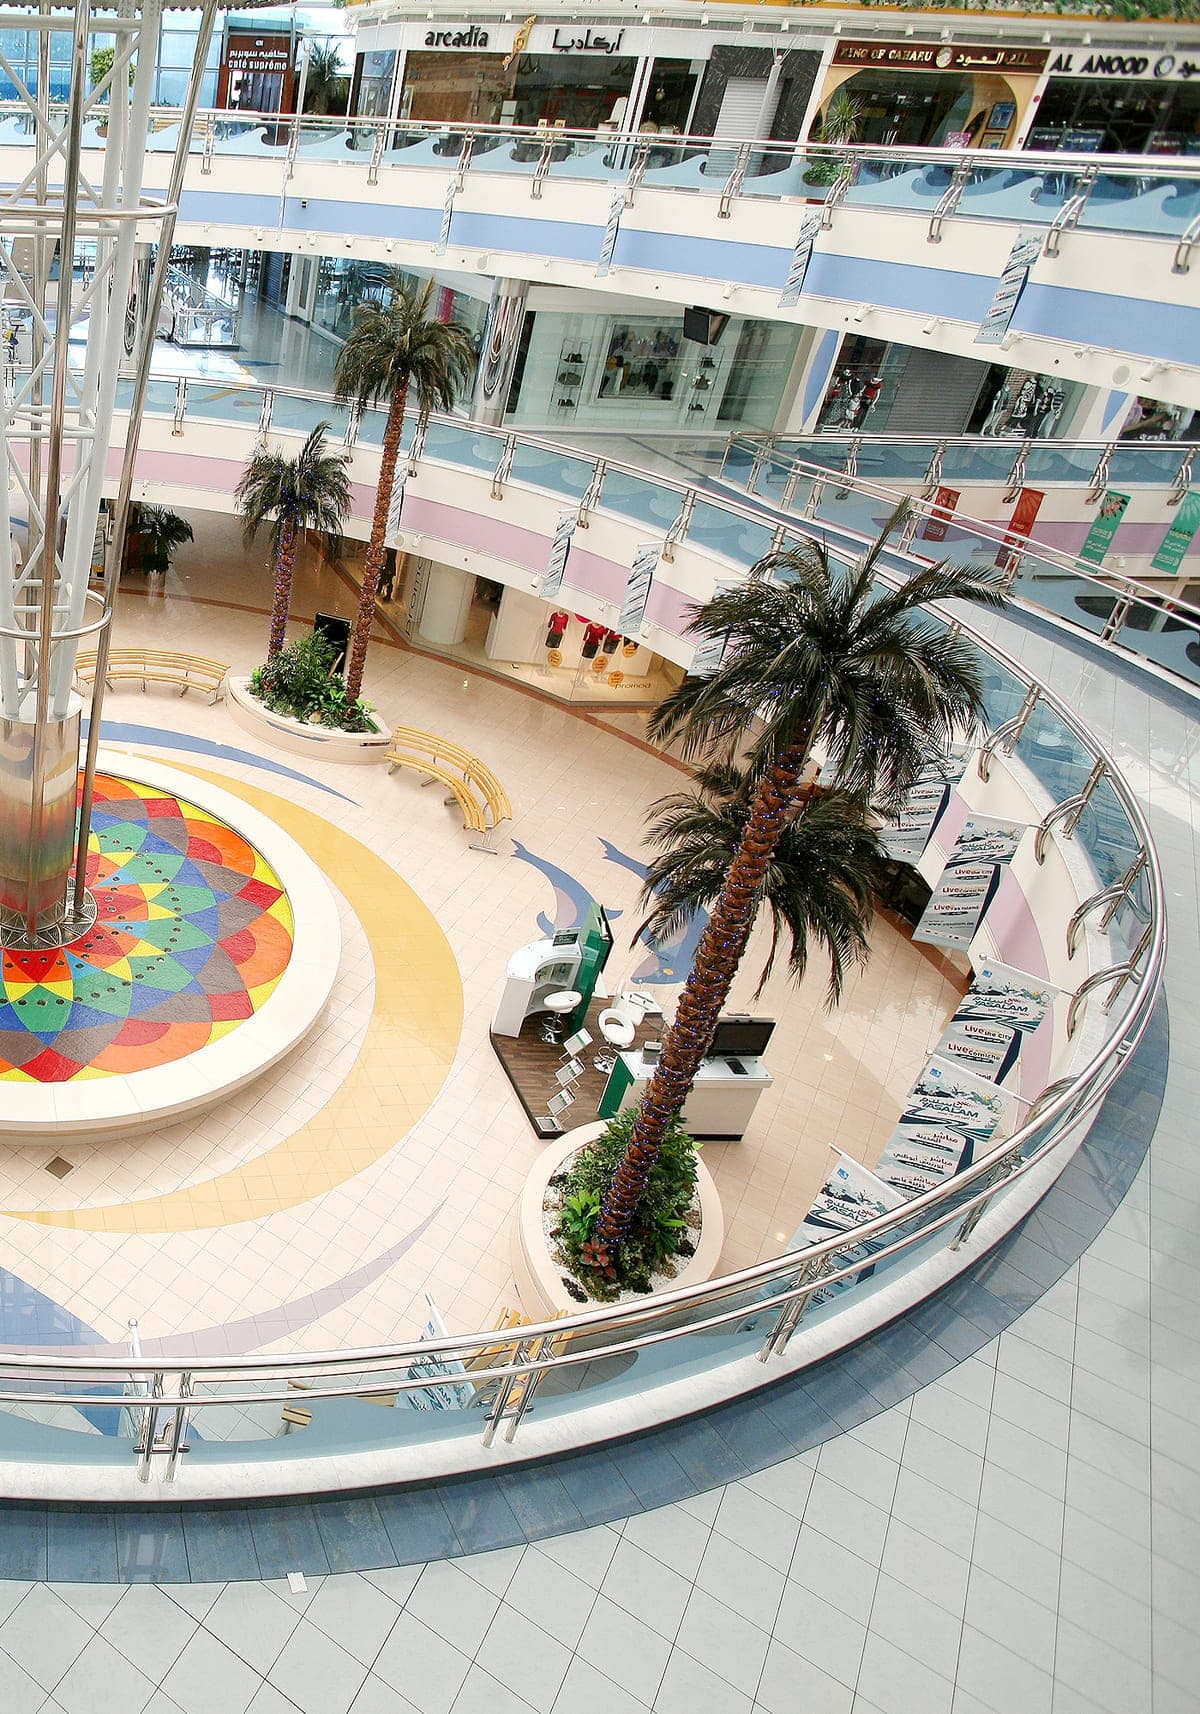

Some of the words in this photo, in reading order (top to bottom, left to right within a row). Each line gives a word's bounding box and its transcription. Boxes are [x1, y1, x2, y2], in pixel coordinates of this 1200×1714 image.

[1050, 54, 1073, 72] AL
[1080, 54, 1149, 75] ANOOD
[614, 682, 651, 690] promod
[955, 868, 972, 876] Live
[934, 904, 951, 912] Live
[974, 1000, 1028, 1013] YASALAM
[965, 1024, 985, 1034] Live
[948, 1043, 969, 1055] Live
[921, 1101, 980, 1118] YASALAM
[826, 1202, 870, 1224] YASAL
